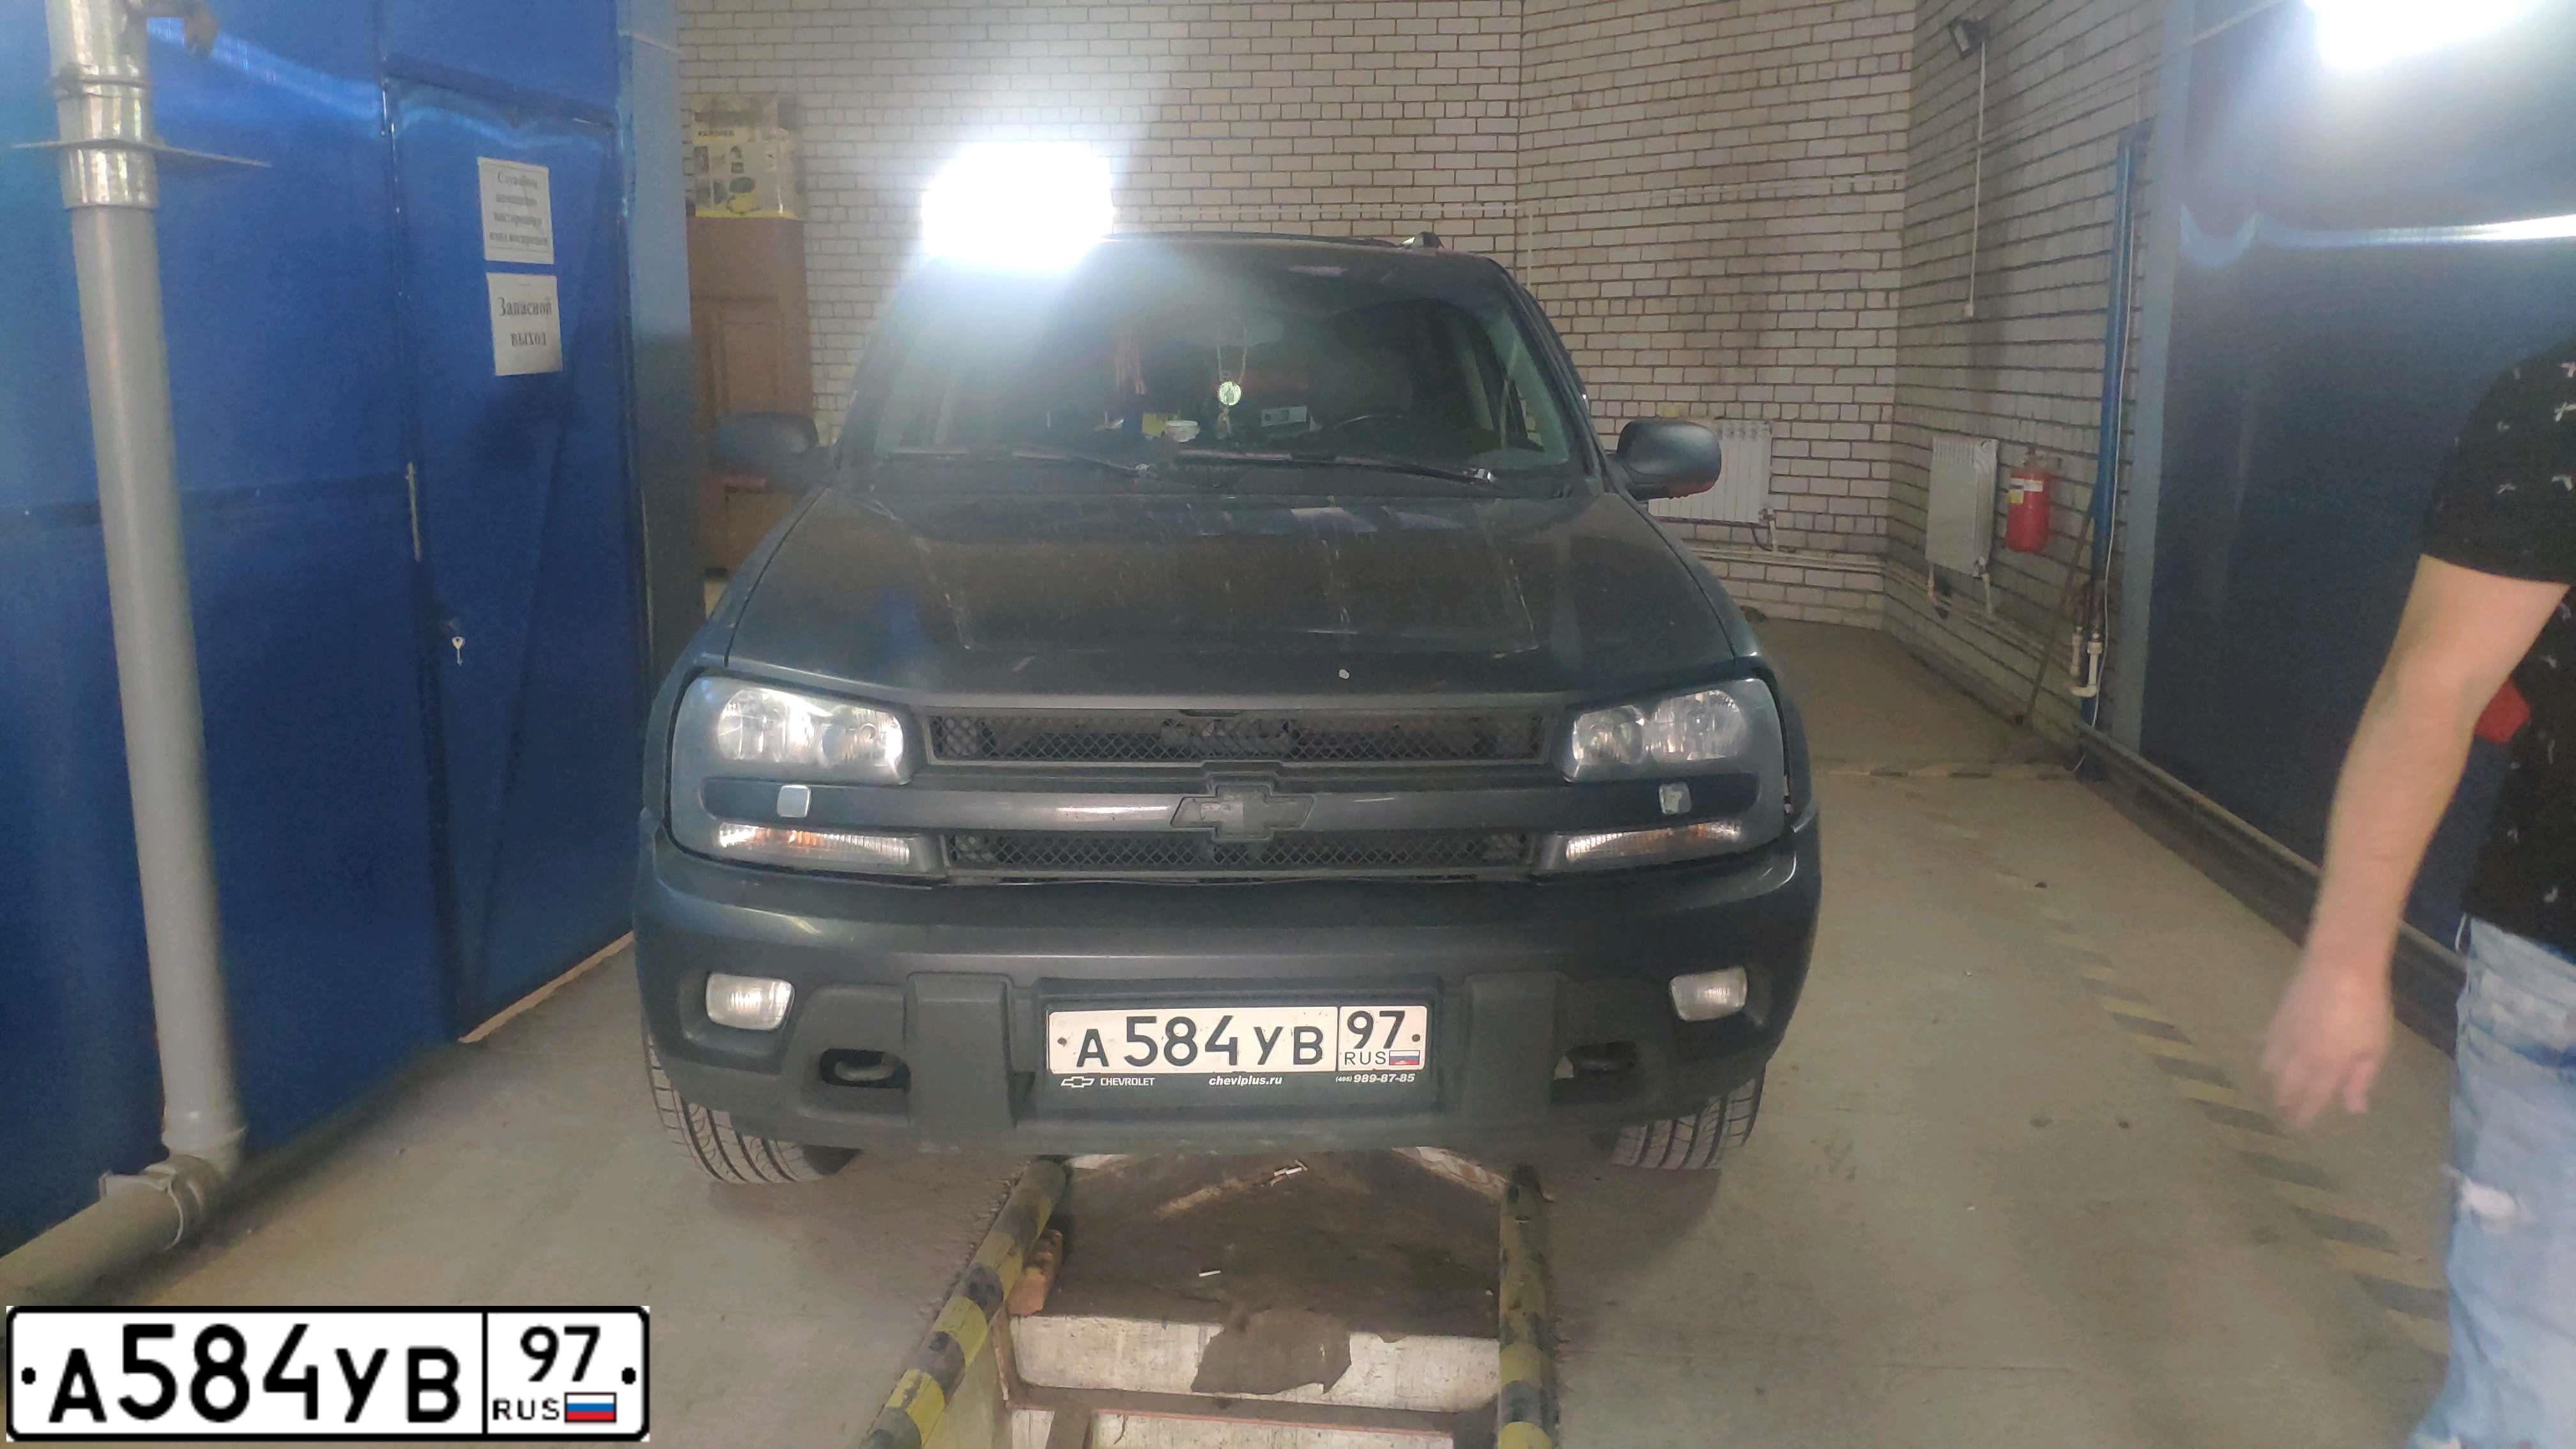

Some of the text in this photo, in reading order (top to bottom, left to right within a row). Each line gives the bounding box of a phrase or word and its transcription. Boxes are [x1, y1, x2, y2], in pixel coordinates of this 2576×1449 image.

[498, 296, 553, 316] Запасной
[510, 332, 547, 348] выход
[1347, 1010, 1406, 1049] 97
[1344, 1051, 1386, 1065] RUS
[1100, 1077, 1155, 1086] CHEVROLET
[1353, 1073, 1416, 1083] 989-87-85
